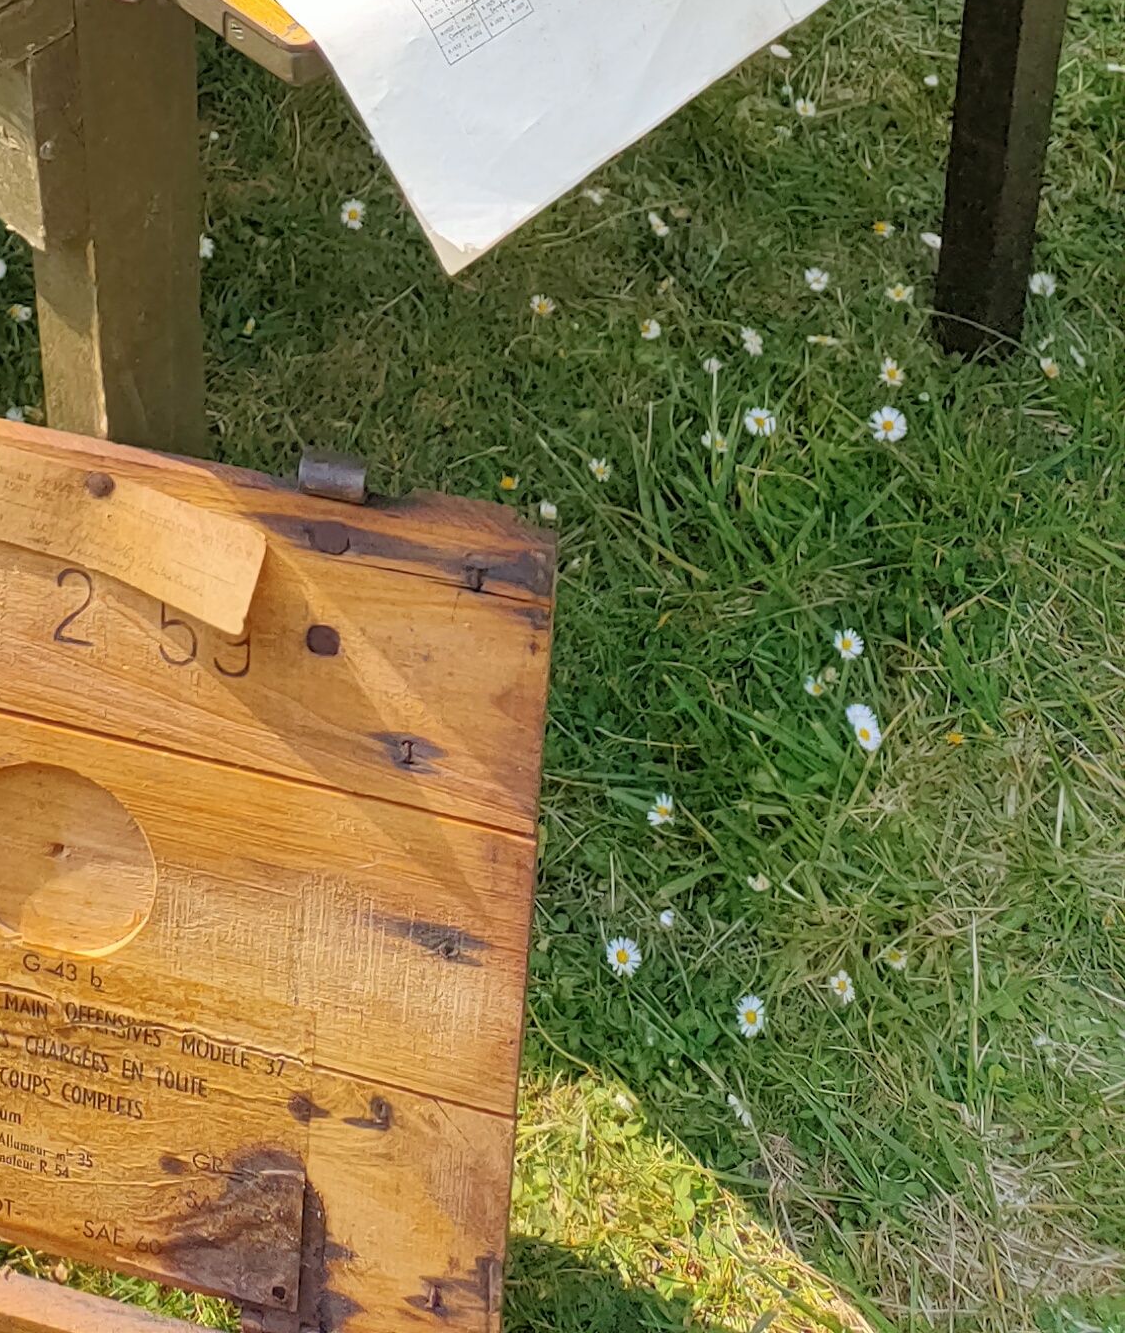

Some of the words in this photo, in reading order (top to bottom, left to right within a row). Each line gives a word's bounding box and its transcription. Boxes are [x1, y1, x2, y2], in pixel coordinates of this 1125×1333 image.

[53, 567, 94, 648] 2
[4, 993, 49, 1019] MAIN
[265, 1058, 286, 1078] 37
[0, 1067, 51, 1097] COUPS
[61, 1081, 144, 1121] COMPLETS
[25, 1034, 110, 1074] CHARGÉES
[121, 1058, 144, 1082] EN
[156, 1067, 208, 1099] TOLITE
[39, 1159, 49, 1175] R
[54, 1163, 70, 1179] 54
[77, 1152, 94, 1169] 35
